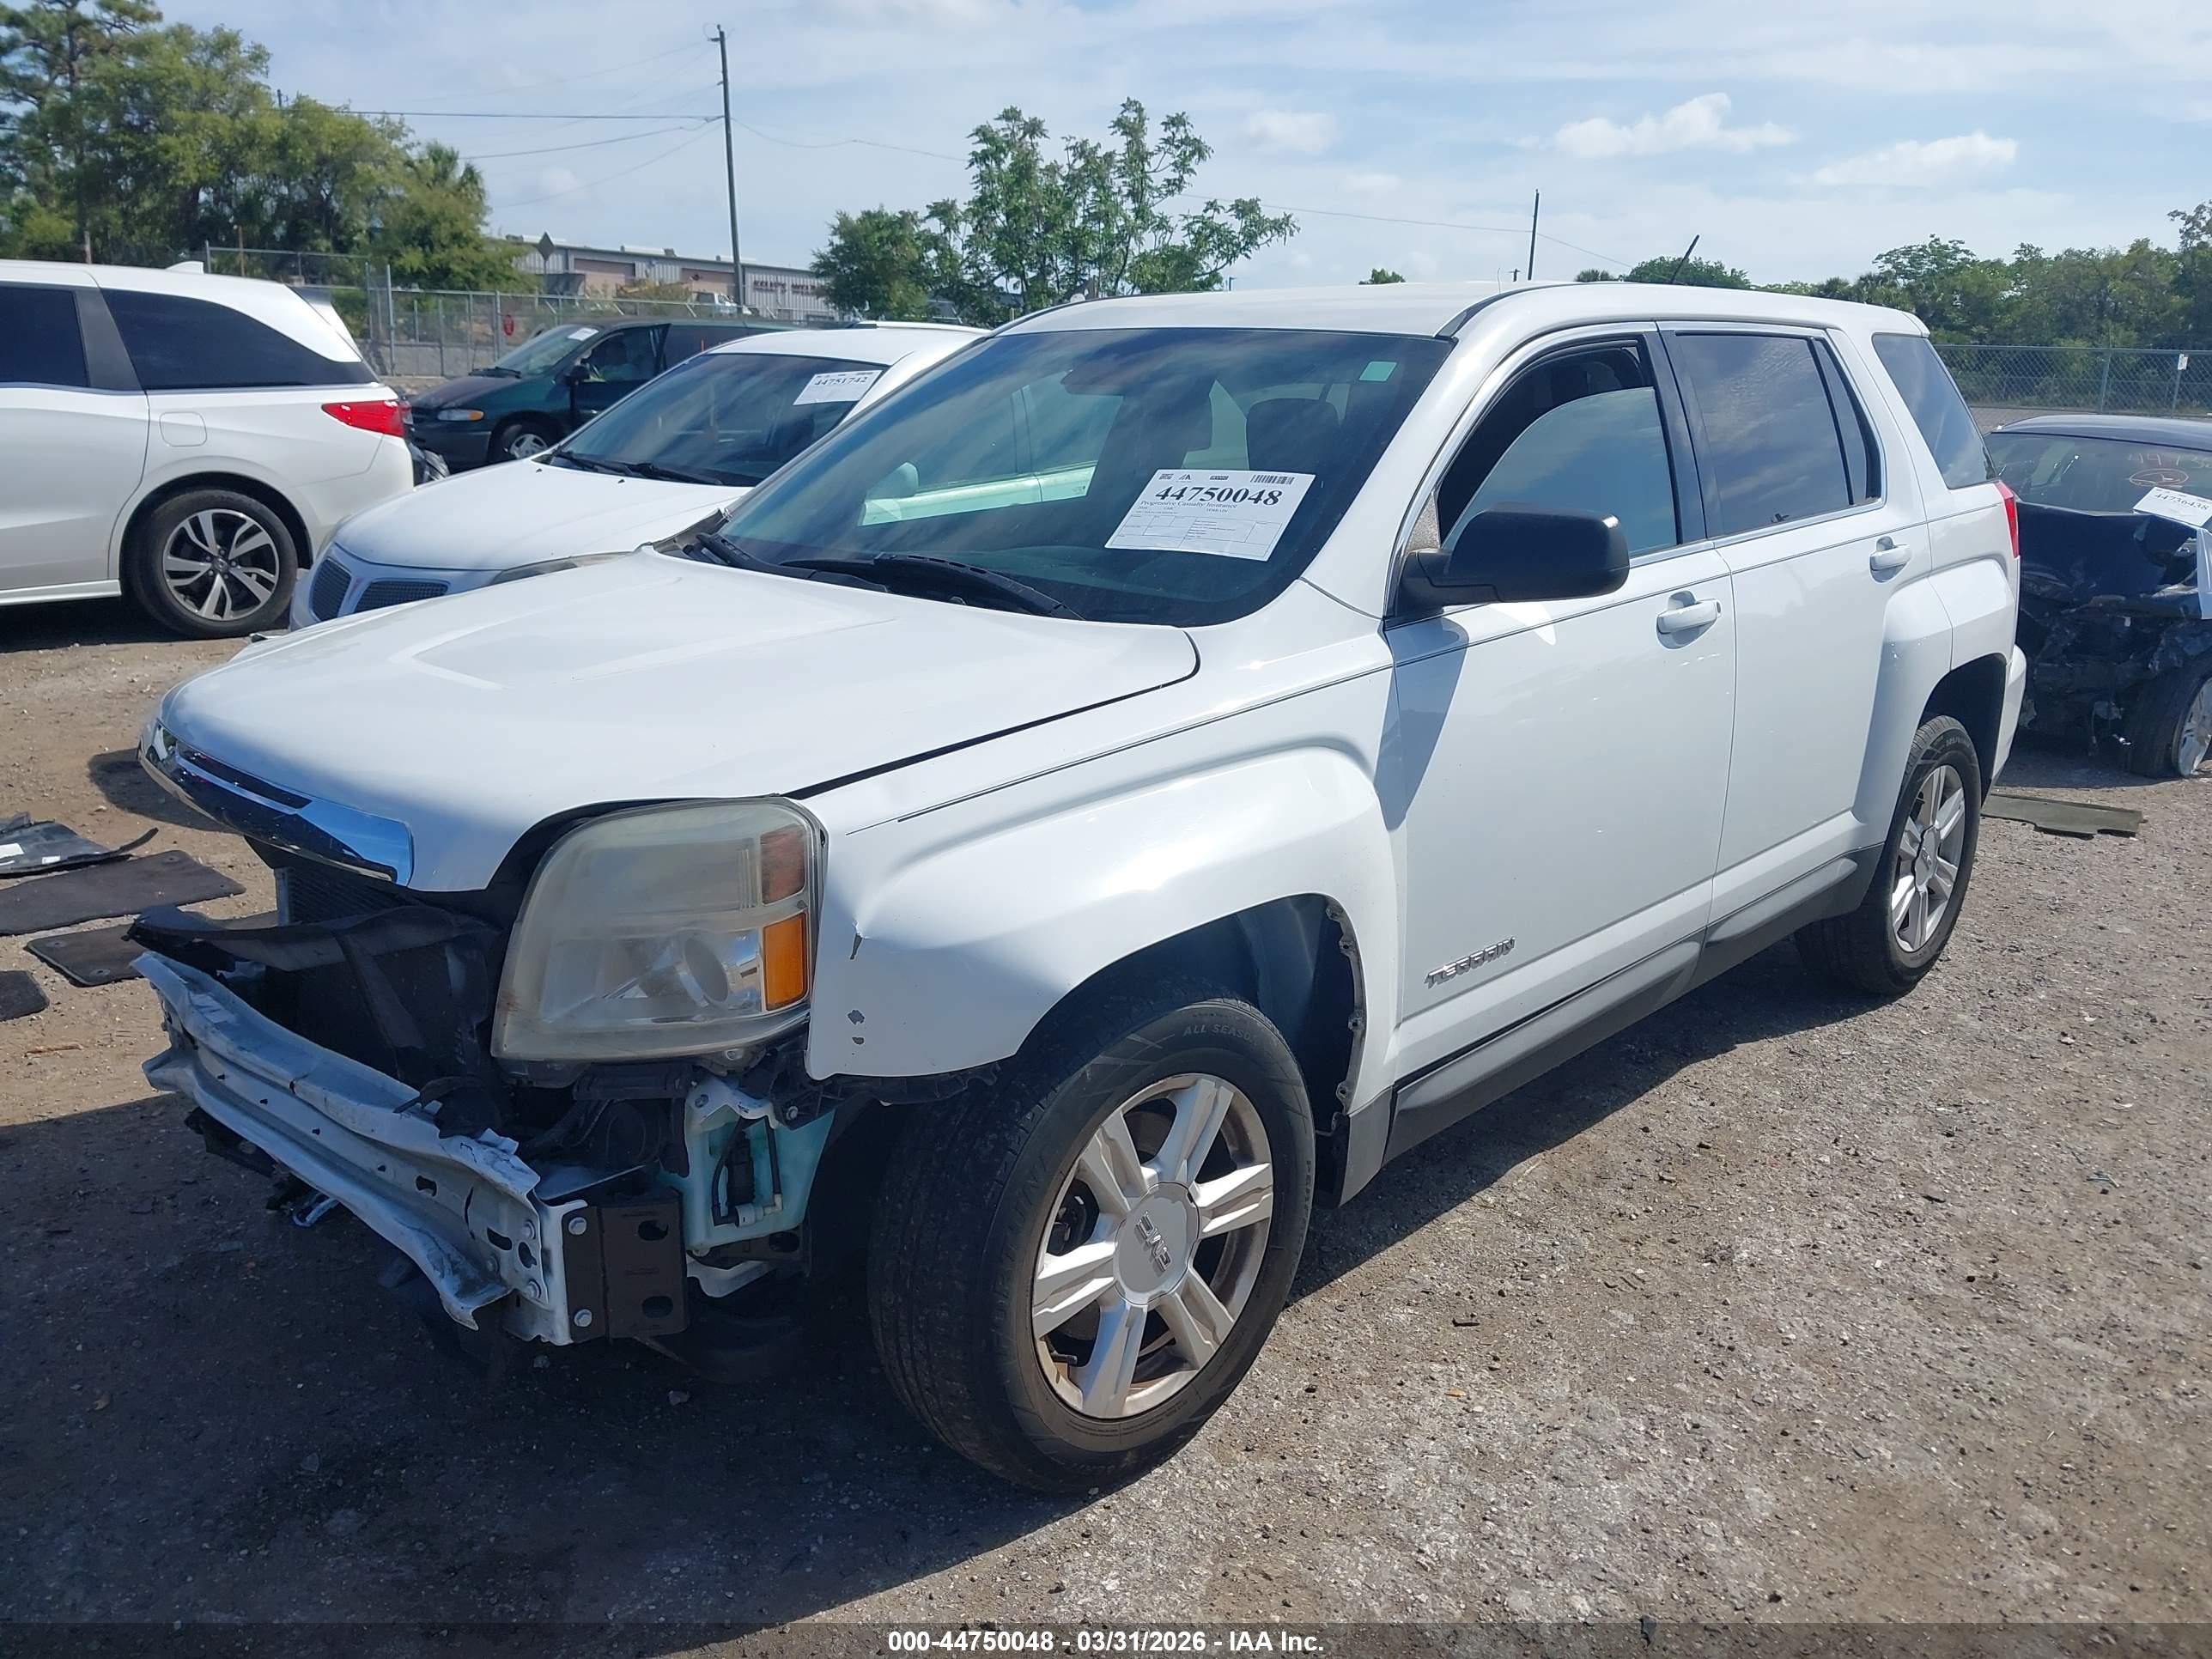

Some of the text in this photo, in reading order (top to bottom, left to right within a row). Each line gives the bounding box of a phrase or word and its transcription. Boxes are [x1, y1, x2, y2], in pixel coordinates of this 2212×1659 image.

[1155, 486, 1283, 506] 44750048
[1424, 936, 1516, 989] TERRAIN
[1182, 1024, 1207, 1037] ALL
[1133, 1210, 1173, 1273] GMC
